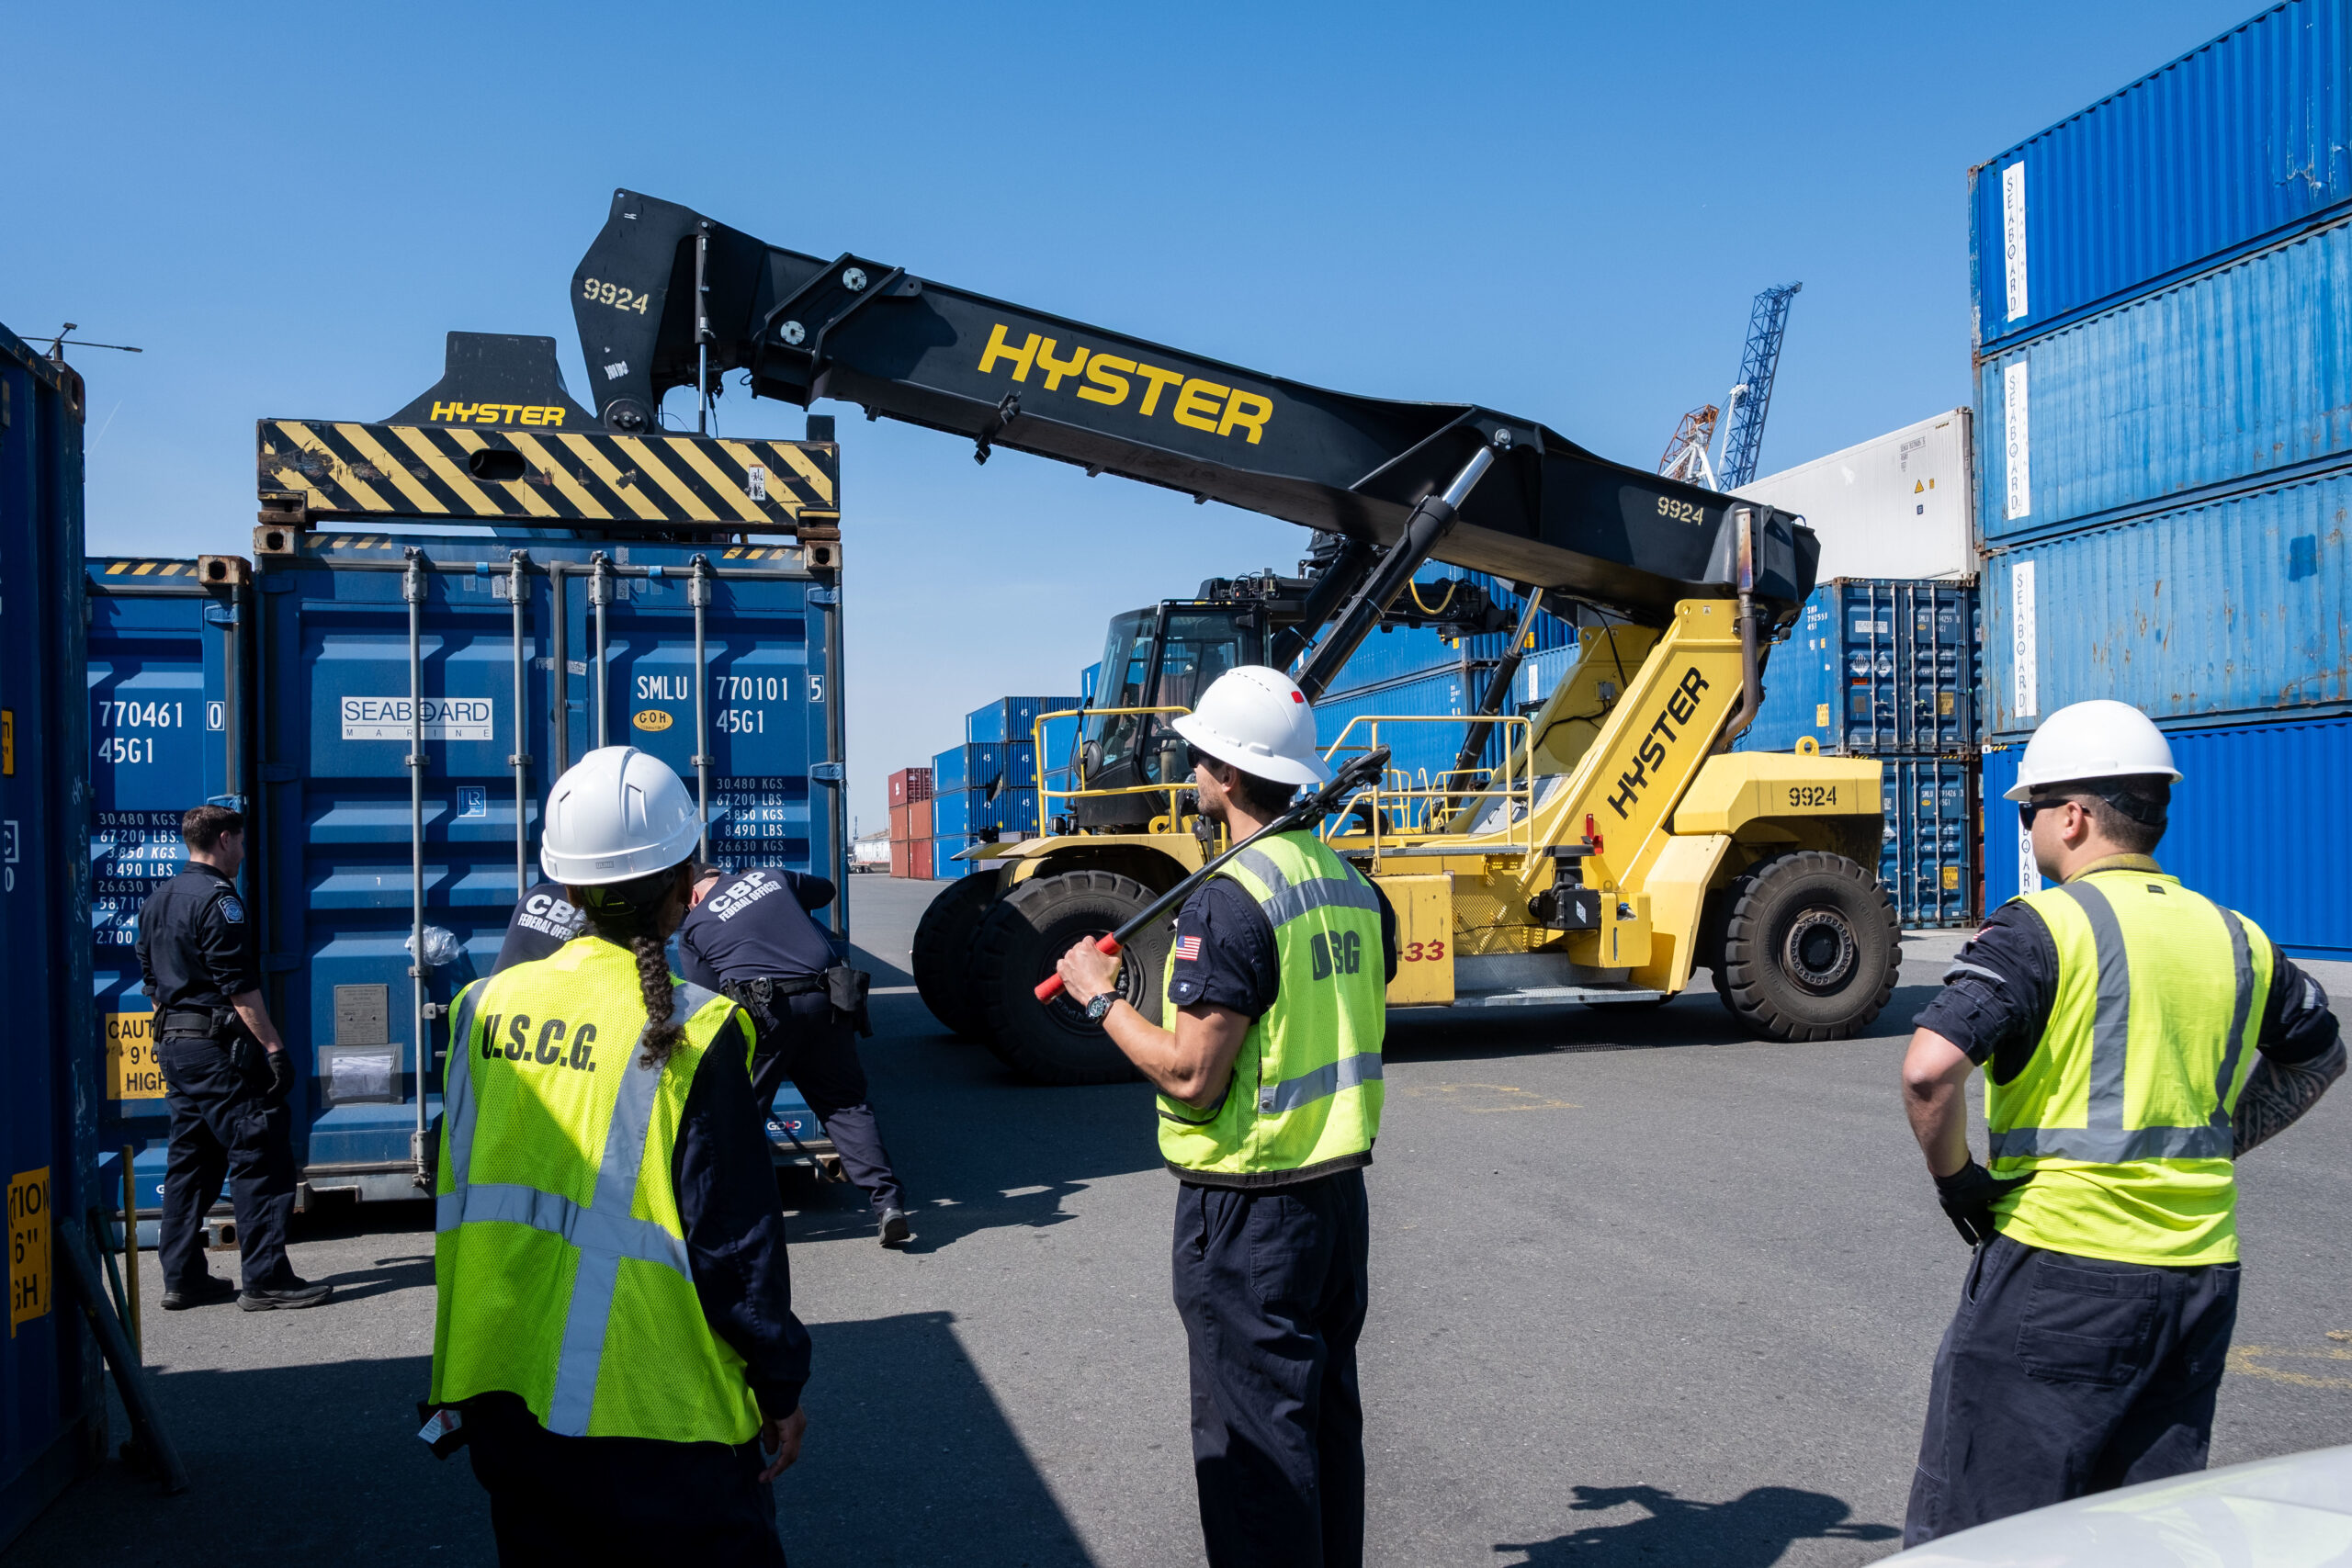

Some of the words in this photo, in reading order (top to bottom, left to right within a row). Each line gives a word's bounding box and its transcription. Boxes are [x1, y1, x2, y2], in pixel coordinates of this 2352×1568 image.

[583, 278, 649, 314] 9924
[978, 323, 1274, 445] HYSTER
[430, 400, 566, 426] HYSTER
[1657, 496, 1704, 526] 9924
[638, 676, 688, 700] SMLU
[717, 677, 787, 701] 770101
[809, 676, 824, 701] 5
[98, 701, 184, 728] 770461
[208, 703, 224, 729] 0
[345, 701, 490, 723] SEABOARD
[639, 712, 667, 724] GOH
[1020, 708, 1028, 716] 45
[717, 709, 763, 734] 45G1
[345, 728, 490, 737] MARINE
[1607, 666, 1710, 820] HYSTER
[98, 738, 153, 763] 45G1
[983, 753, 991, 761] 45
[1022, 754, 1030, 762] 45
[716, 778, 756, 790] 30.480
[762, 778, 786, 790] KGS.
[717, 794, 756, 807] 67.200
[762, 794, 785, 807] LBS.
[1022, 798, 1030, 807] 45
[1789, 785, 1838, 807] 9924
[98, 813, 145, 826] 30.480
[152, 813, 180, 826] KGS.
[724, 809, 756, 821] 3.850
[762, 809, 786, 821] KGS.
[100, 829, 145, 843] 67.200
[153, 829, 180, 843] LBS.
[725, 824, 756, 837] 8.490
[763, 824, 786, 837] LBS.
[107, 846, 144, 860] 3.850
[151, 846, 178, 860] KGS.
[718, 840, 756, 852] 26.630
[763, 840, 787, 852] KGS.
[718, 855, 756, 869] 58.710
[763, 855, 786, 868] LBS.
[106, 863, 142, 876] 8.490
[150, 863, 176, 876] LBS.
[97, 880, 144, 893] 26.630
[708, 872, 766, 913] CBP
[99, 897, 145, 910] 58.710
[718, 895, 753, 922] FEDERAL
[749, 880, 782, 901] OFFICER
[517, 912, 553, 933] FEDERAL
[107, 1019, 155, 1039] CAUT
[481, 1012, 598, 1073] U.S.C.G.
[130, 1045, 159, 1066] 9'6
